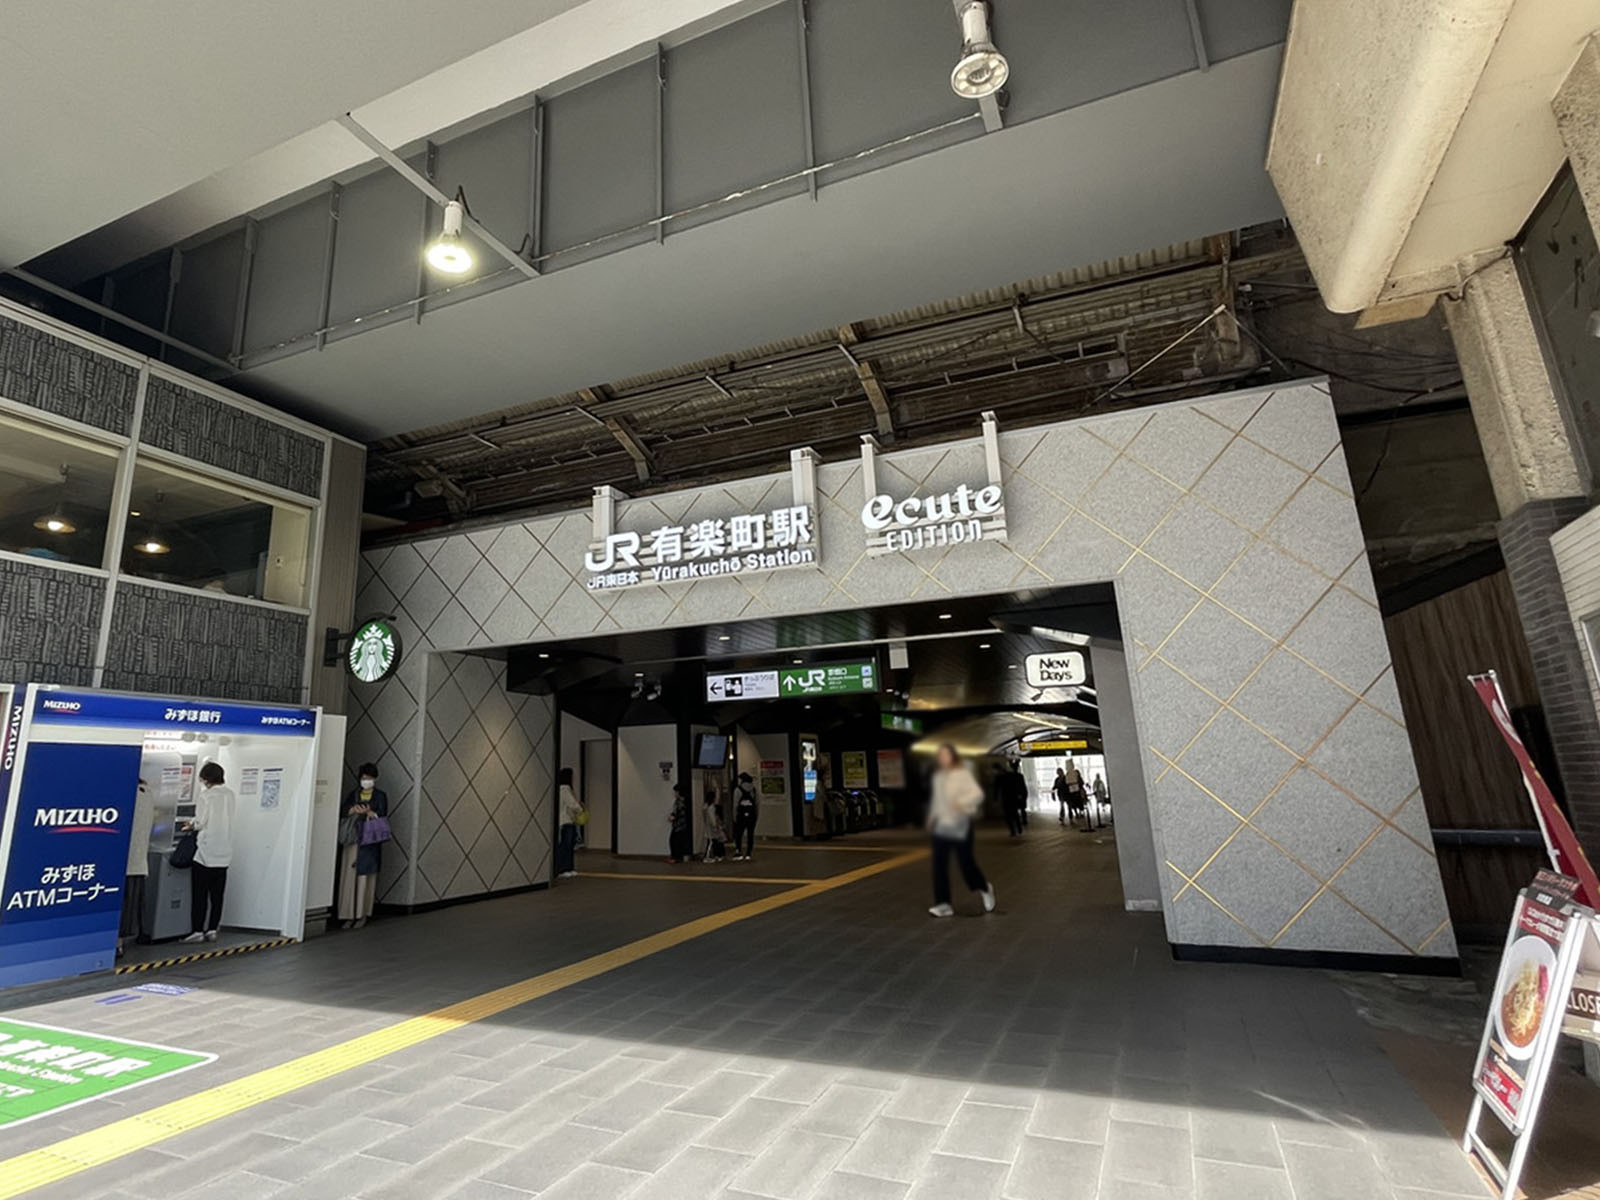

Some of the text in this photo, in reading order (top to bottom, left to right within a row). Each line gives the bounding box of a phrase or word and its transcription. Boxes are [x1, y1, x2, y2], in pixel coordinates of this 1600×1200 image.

[861, 484, 1002, 530] ecute
[585, 506, 810, 572] JR 有楽町駅
[886, 519, 983, 552] EDITION
[746, 548, 813, 570] Station
[587, 571, 639, 589] JR東日本
[1040, 658, 1069, 669] New
[798, 669, 826, 686] JR
[1040, 670, 1073, 681] Days
[43, 700, 81, 710] MIZUHO
[164, 708, 221, 723] みずほ銀行
[4, 706, 22, 770] MIZUHO
[33, 807, 119, 826] MIZUHO
[41, 864, 96, 884] みずほ
[6, 886, 120, 911] ATMコーナー
